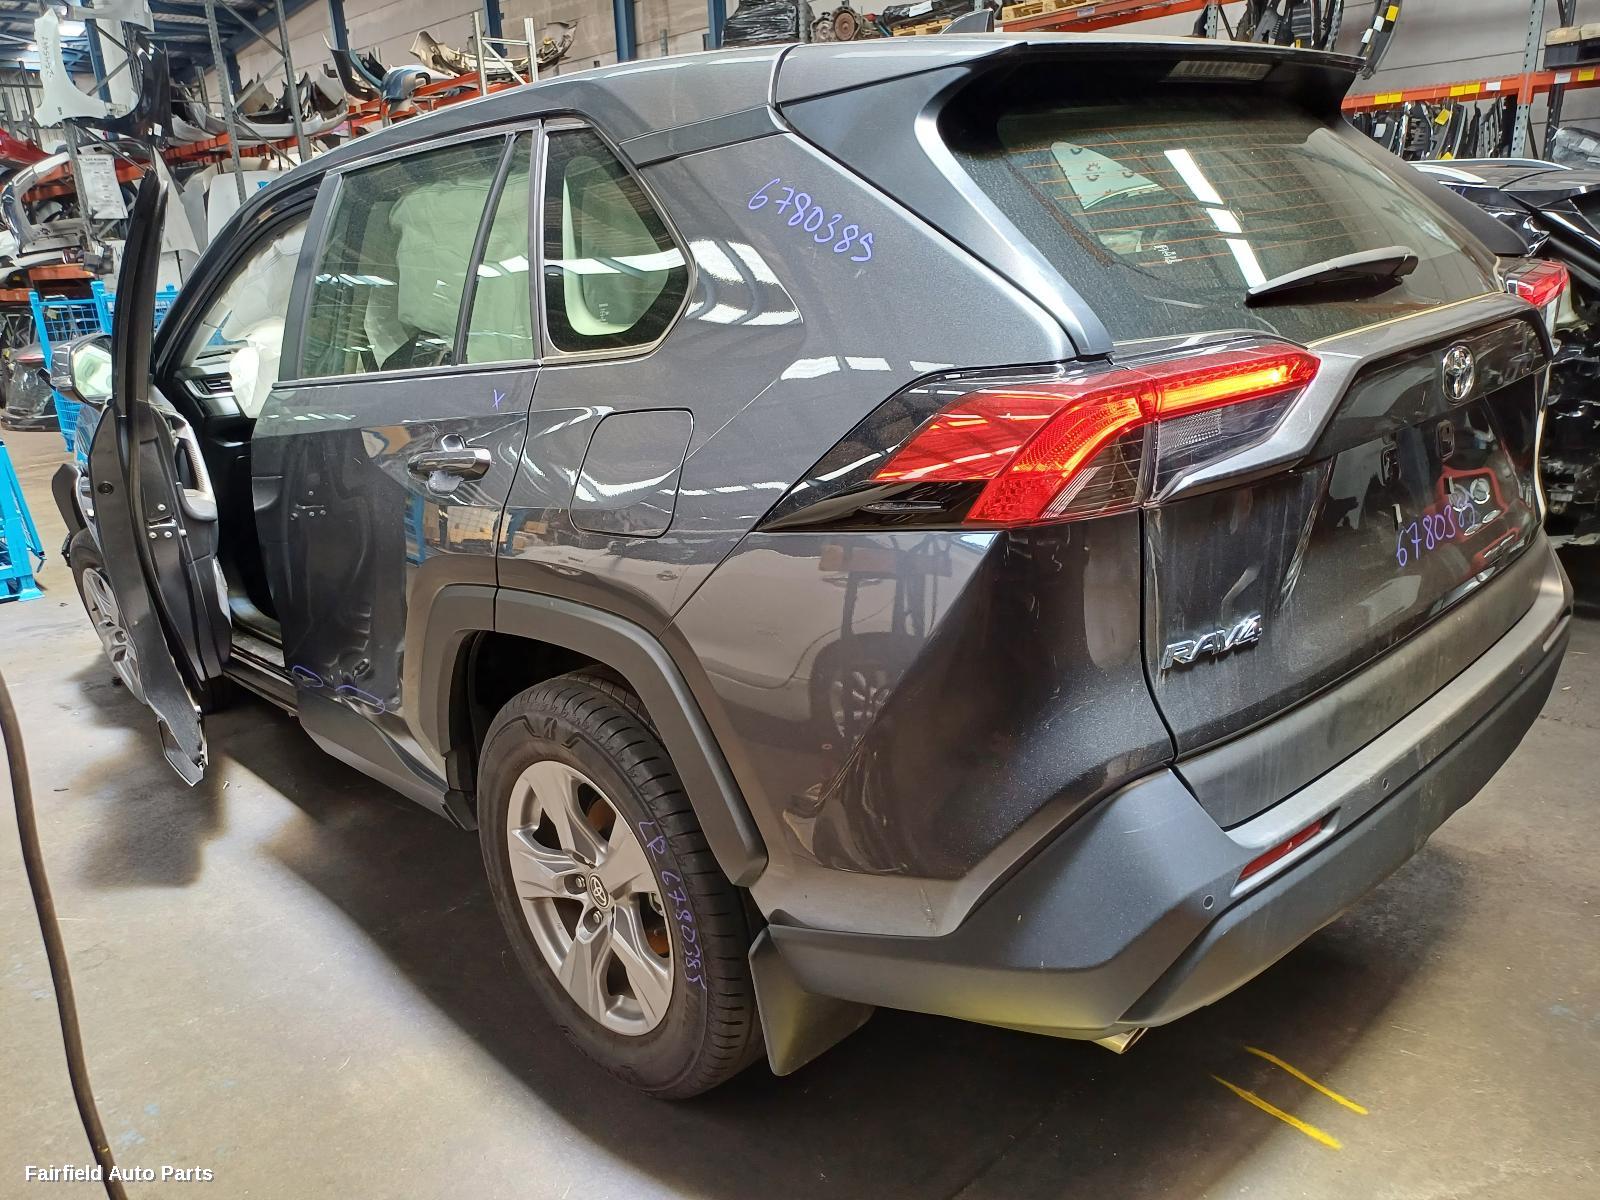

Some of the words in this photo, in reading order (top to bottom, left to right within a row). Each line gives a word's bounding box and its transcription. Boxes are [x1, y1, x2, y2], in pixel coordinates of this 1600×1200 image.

[748, 177, 874, 262] 6780385
[1160, 614, 1263, 670] RAV4
[661, 870, 708, 990] 6780385
